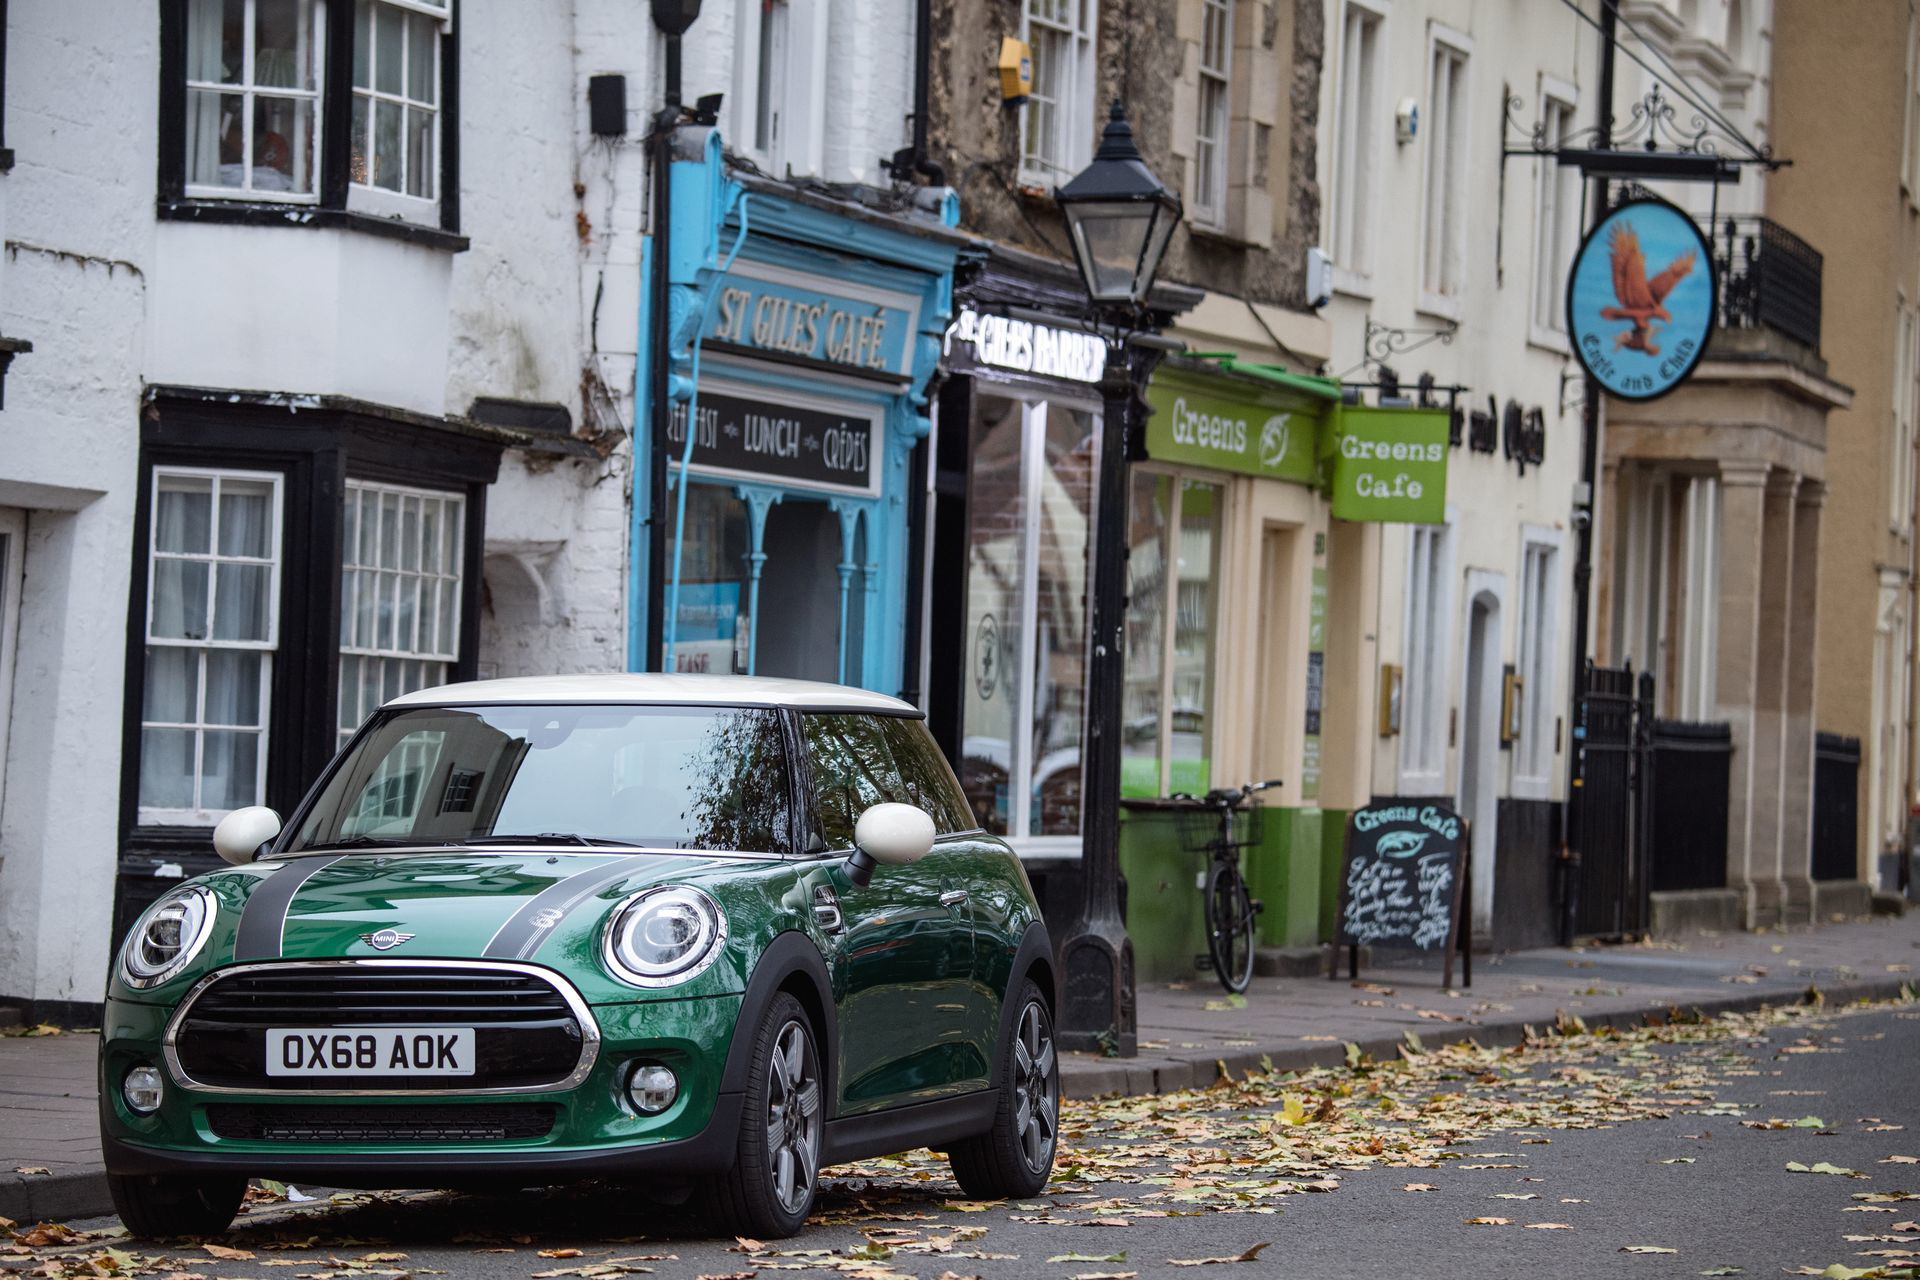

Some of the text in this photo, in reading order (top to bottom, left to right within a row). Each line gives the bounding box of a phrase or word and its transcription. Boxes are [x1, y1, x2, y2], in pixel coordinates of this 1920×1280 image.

[714, 286, 751, 342] ST
[753, 294, 829, 355] GILES'
[980, 313, 1034, 372] GILES
[743, 413, 801, 459] LUNCH
[1171, 398, 1247, 454] Greens
[1340, 434, 1443, 462] Greens
[1355, 472, 1423, 499] Cafe
[1355, 805, 1459, 840] Greens Cafe
[375, 935, 396, 943] MINI
[282, 1034, 459, 1069] OX68 AOK
